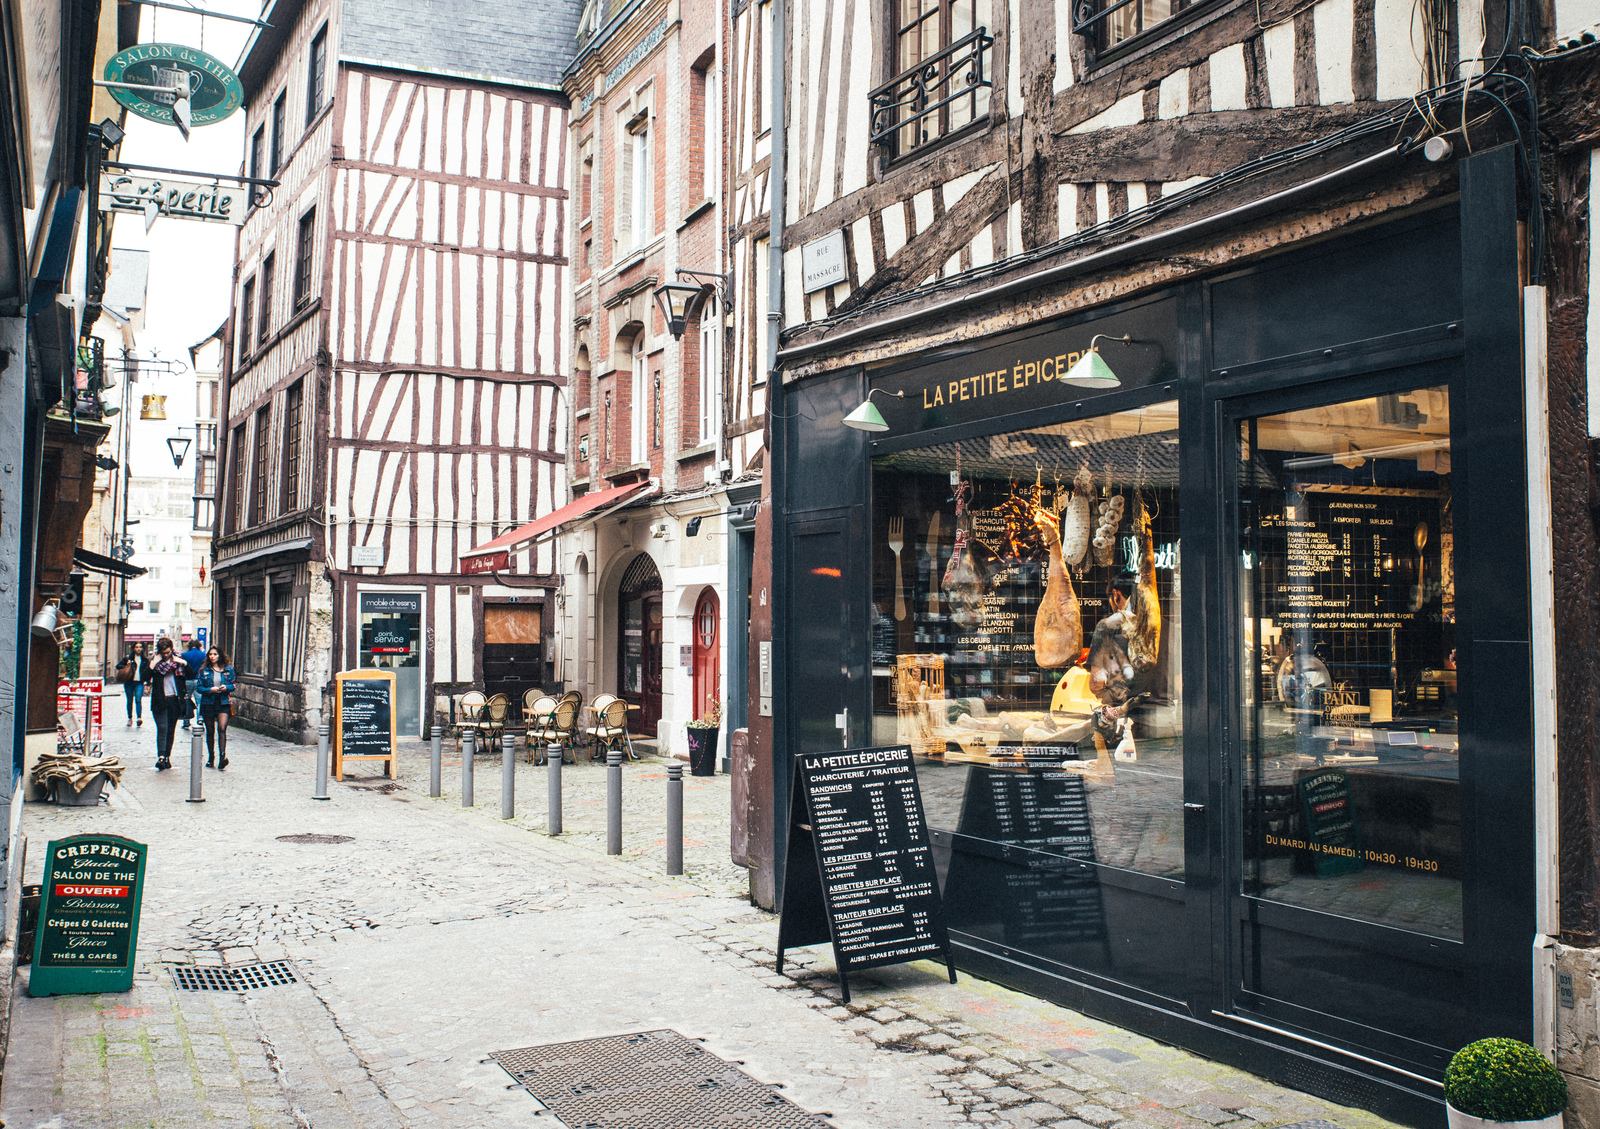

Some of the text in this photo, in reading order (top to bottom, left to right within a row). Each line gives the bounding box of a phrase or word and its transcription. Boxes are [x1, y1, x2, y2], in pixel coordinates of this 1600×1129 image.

[116, 46, 234, 86] SALON de THE
[816, 246, 829, 256] RUE
[808, 264, 840, 282] MASSACRE
[923, 346, 1099, 409] LA PETITE ÉPICER
[366, 598, 416, 610] mobile dressing
[1324, 692, 1355, 705] PAIN
[806, 750, 909, 769] LA PETITE ÉPICERIE
[810, 771, 865, 782] CHARCUTERIE
[872, 766, 909, 776] TRAITEUR
[810, 784, 852, 793] SANDWICHS
[57, 844, 137, 862] CREPERIE
[837, 852, 872, 862] PIZZETTES
[1266, 834, 1439, 872] DU MARDI AU SAMEDI 10H30 19H30
[71, 858, 120, 869] Glacier
[53, 871, 135, 881] SALON DE THE
[829, 881, 864, 892] ASSIETTES
[880, 876, 901, 884] PLACE
[63, 887, 122, 895] OUVERT
[832, 892, 863, 901] CHARCUTERIE
[62, 898, 120, 908] Boissons
[834, 904, 904, 921] TRAITEUR SUR PLACE
[48, 919, 79, 928] Crêpes
[91, 920, 128, 928] Galettes
[839, 922, 863, 930] LASAGNE
[840, 923, 904, 937] MELANZANE PARMIGIANA
[66, 937, 107, 949] Glaces
[841, 936, 869, 944] MANICOTTI
[842, 942, 875, 951] CANELLONIS
[850, 955, 866, 963] AUSSI
[870, 952, 887, 960] TAPAS
